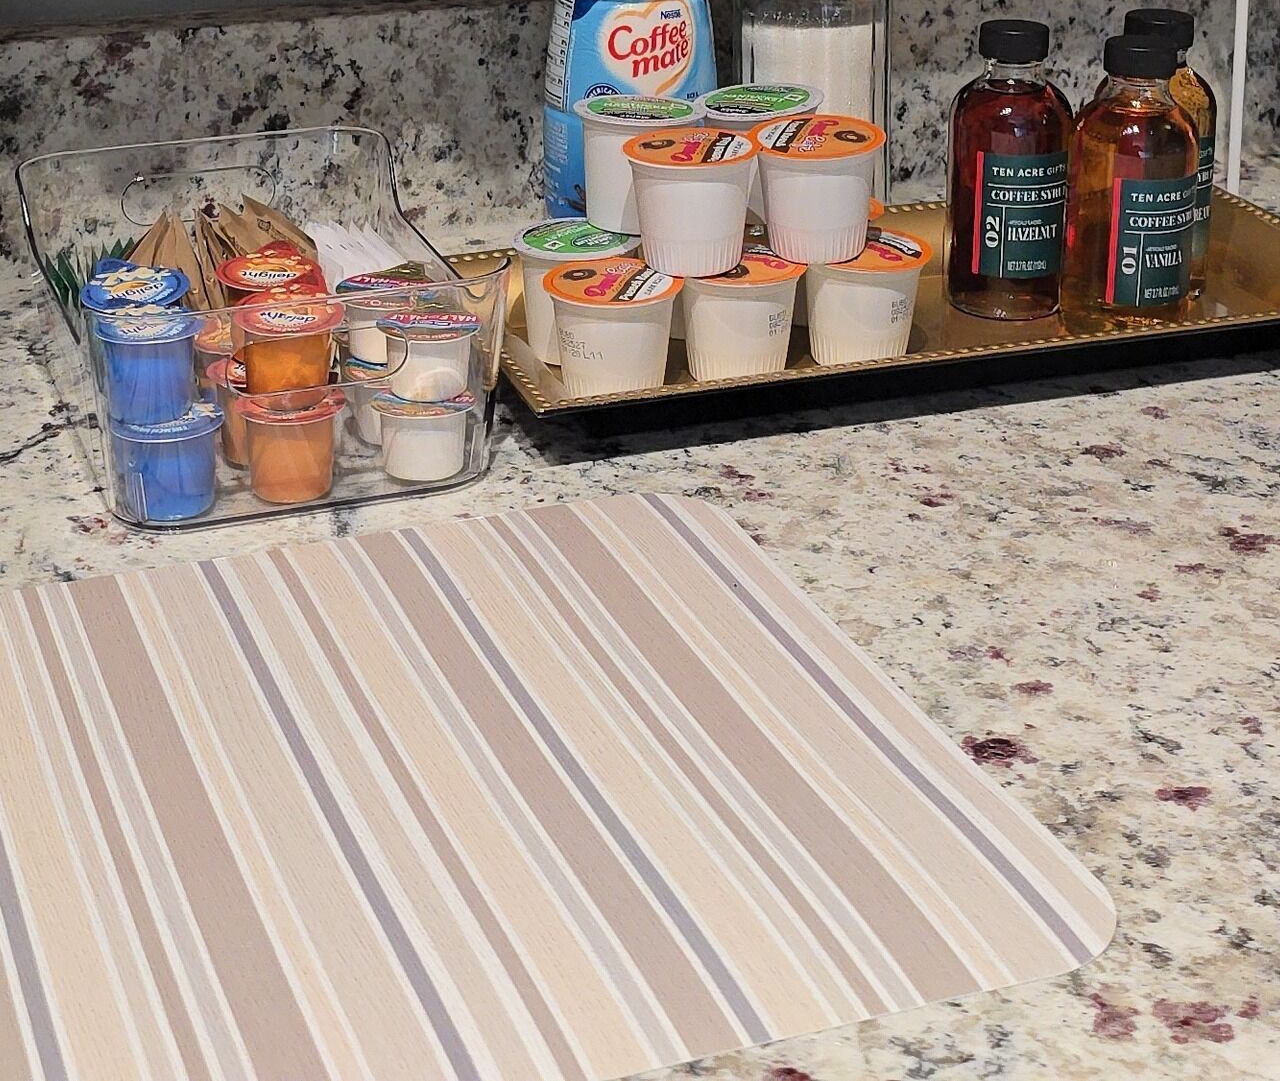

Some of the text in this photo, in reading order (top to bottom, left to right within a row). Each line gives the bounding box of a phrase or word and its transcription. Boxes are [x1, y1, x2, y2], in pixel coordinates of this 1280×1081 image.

[607, 20, 687, 60] Coffee
[631, 38, 690, 78] mate
[991, 166, 1015, 178] TEN
[1017, 167, 1045, 178] ACRE
[990, 189, 1040, 202] COFFEE
[1130, 193, 1154, 203] TEN
[1156, 191, 1182, 203] ACRE
[1129, 214, 1177, 228] COFFEE
[985, 215, 1000, 248] 02
[1007, 223, 1058, 242] HAZELNUT
[1121, 246, 1138, 275] 01
[1145, 249, 1183, 269] VANILLA
[242, 270, 297, 280] delight
[109, 281, 164, 300] delight
[259, 311, 316, 322] delight
[442, 314, 477, 322] HALF
